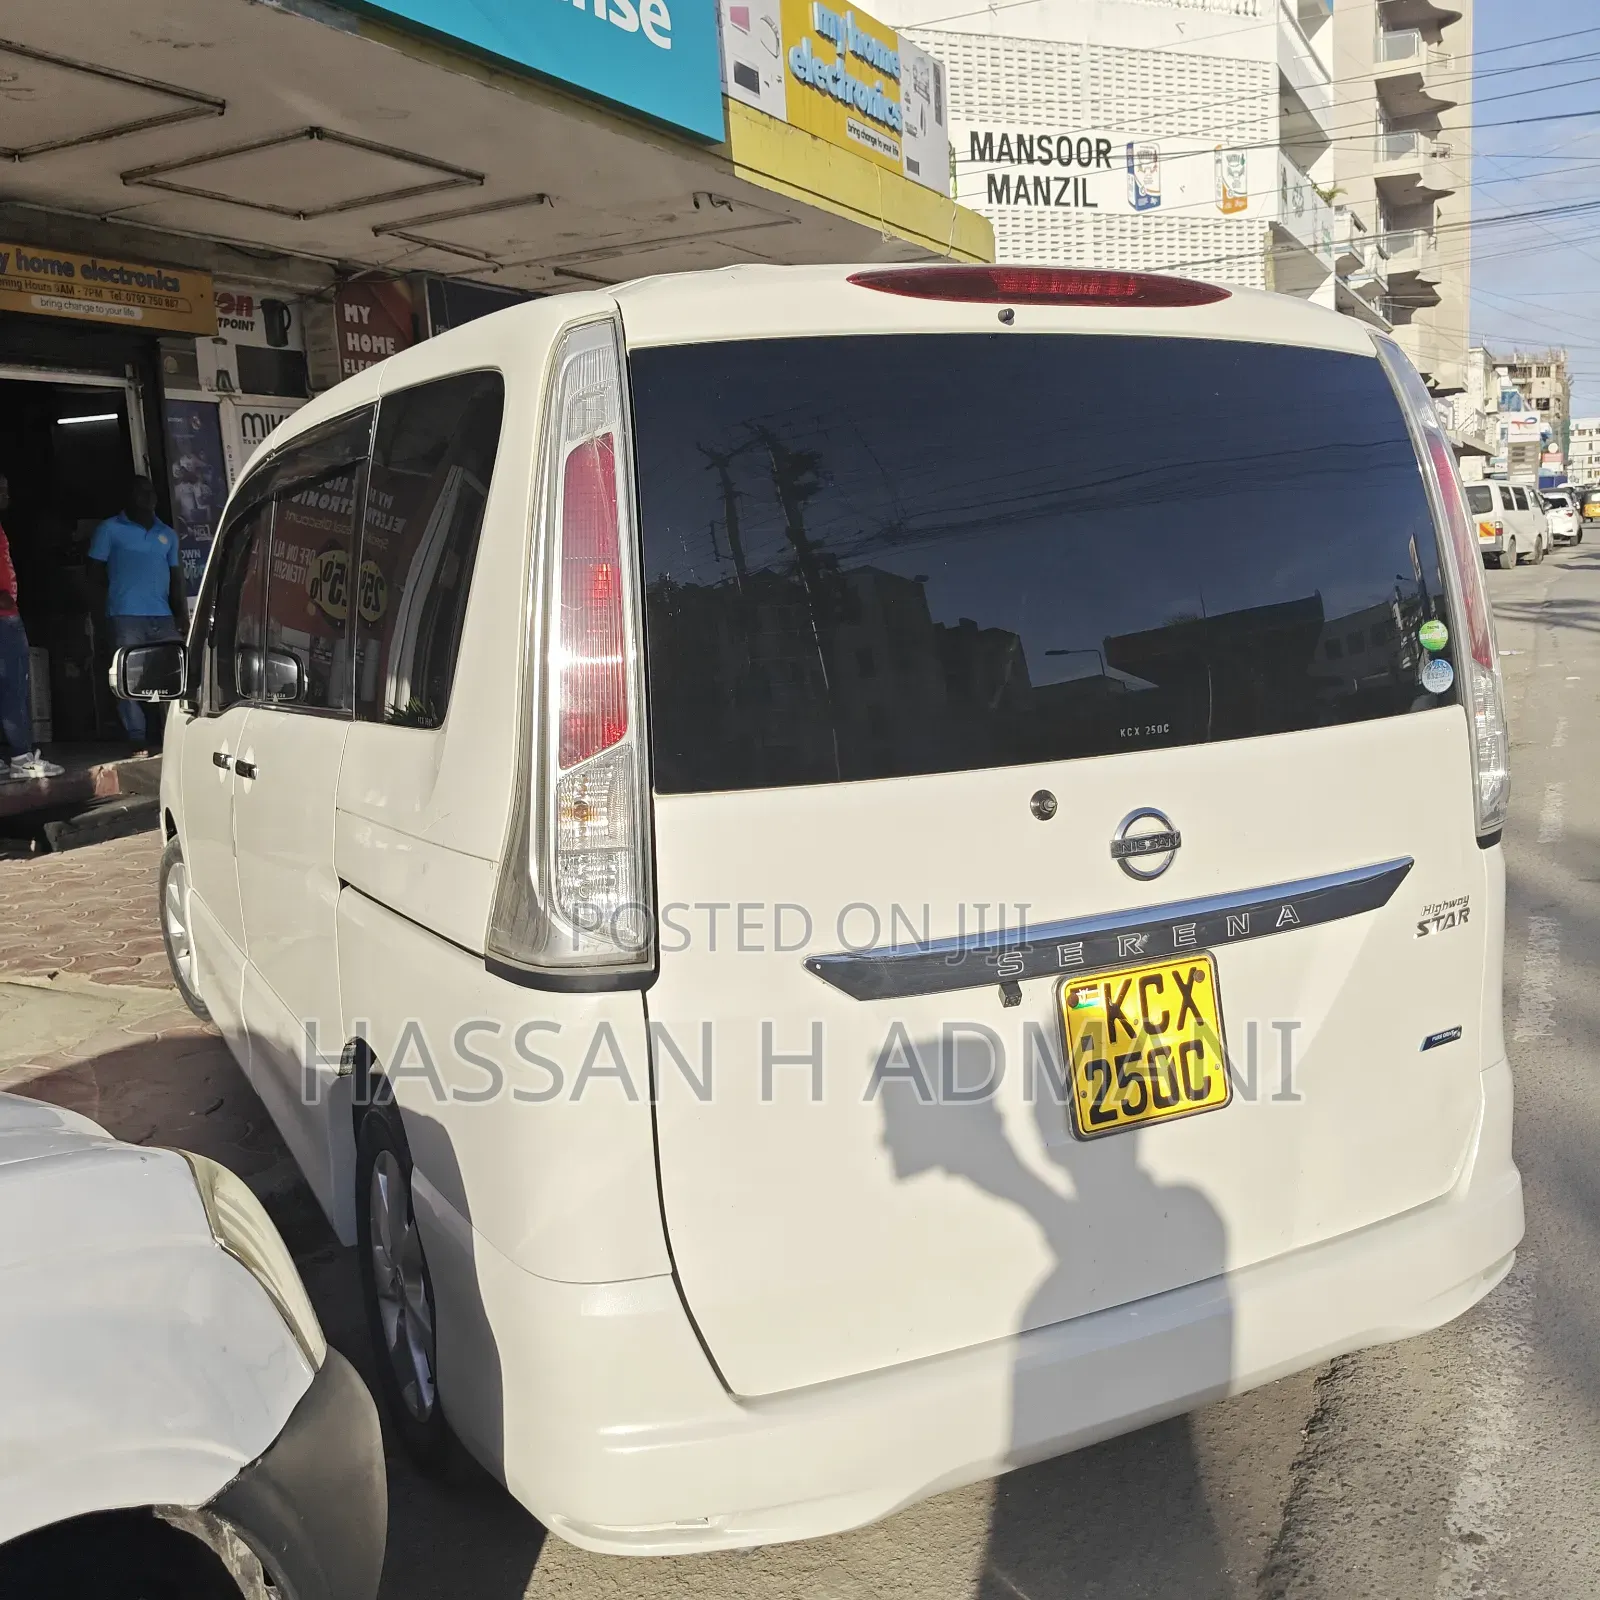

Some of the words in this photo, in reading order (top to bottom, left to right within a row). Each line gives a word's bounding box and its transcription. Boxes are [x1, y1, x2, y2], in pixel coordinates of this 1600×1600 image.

[811, 1, 847, 56] my
[846, 10, 901, 80] home
[788, 37, 902, 132] electronics
[970, 130, 1112, 168] MANSOOR
[987, 173, 1098, 208] MANZIL
[16, 248, 75, 278] home
[80, 259, 180, 292] electronics
[25, 279, 52, 293] Hours
[83, 287, 103, 298] 7PM
[40, 297, 63, 310] bring
[64, 301, 95, 314] change
[96, 304, 104, 313] to
[105, 307, 122, 316] your
[123, 308, 135, 317] life
[344, 303, 370, 324] MY
[347, 332, 396, 355] HOME
[1120, 727, 1140, 738] KCX
[1145, 723, 1170, 736] 250C
[1119, 832, 1179, 854] NISSAN
[1413, 906, 1471, 939] STAR
[1420, 894, 1471, 917] Highway
[996, 903, 1300, 977] SERENA
[1103, 966, 1205, 1044] KCX
[1084, 1039, 1212, 1125] 250C
